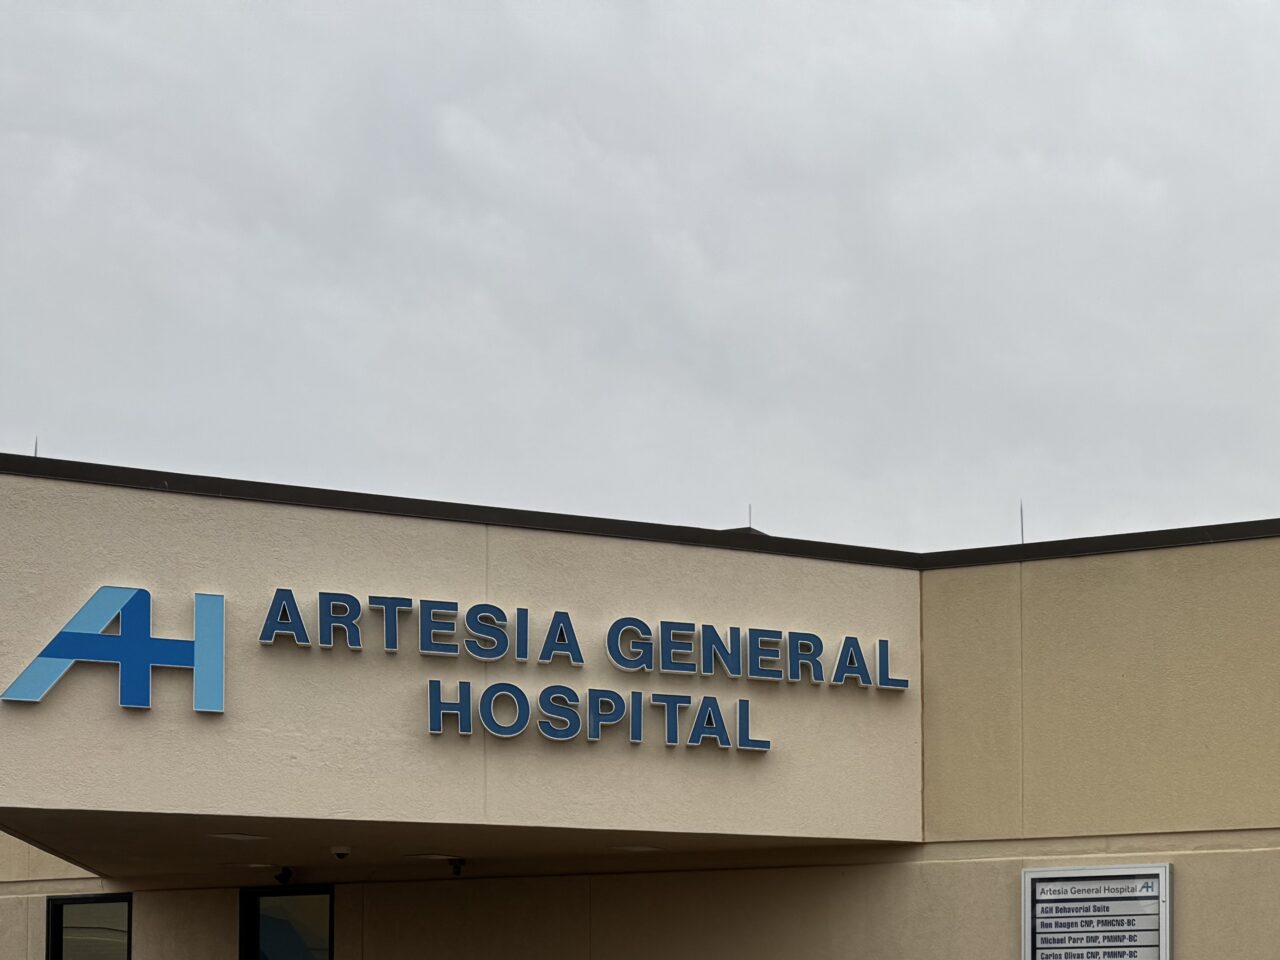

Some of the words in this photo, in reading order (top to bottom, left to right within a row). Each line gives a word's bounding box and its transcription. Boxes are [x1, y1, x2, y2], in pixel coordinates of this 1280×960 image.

[258, 588, 585, 667] ARTESIA
[605, 616, 910, 691] GENERAL
[428, 679, 771, 751] HOSPITAL
[1040, 887, 1068, 896] Artesia
[1070, 886, 1101, 895] General
[1103, 885, 1137, 895] Hospital
[1041, 906, 1053, 914] AGH
[1093, 905, 1110, 913] Suite
[1041, 921, 1053, 929] Ron
[1055, 921, 1079, 930] Haugen
[1081, 920, 1095, 929] CNP,
[1097, 919, 1136, 928] PMHCNS-BC
[1041, 936, 1066, 945] Michael
[1068, 936, 1084, 944] Parr
[1103, 935, 1138, 943] PMHNP-BC
[1041, 952, 1062, 960] Carlos
[1064, 952, 1084, 960] Olivas
[1086, 951, 1101, 960] CNP,
[1103, 950, 1138, 959] PMHNP-BC
